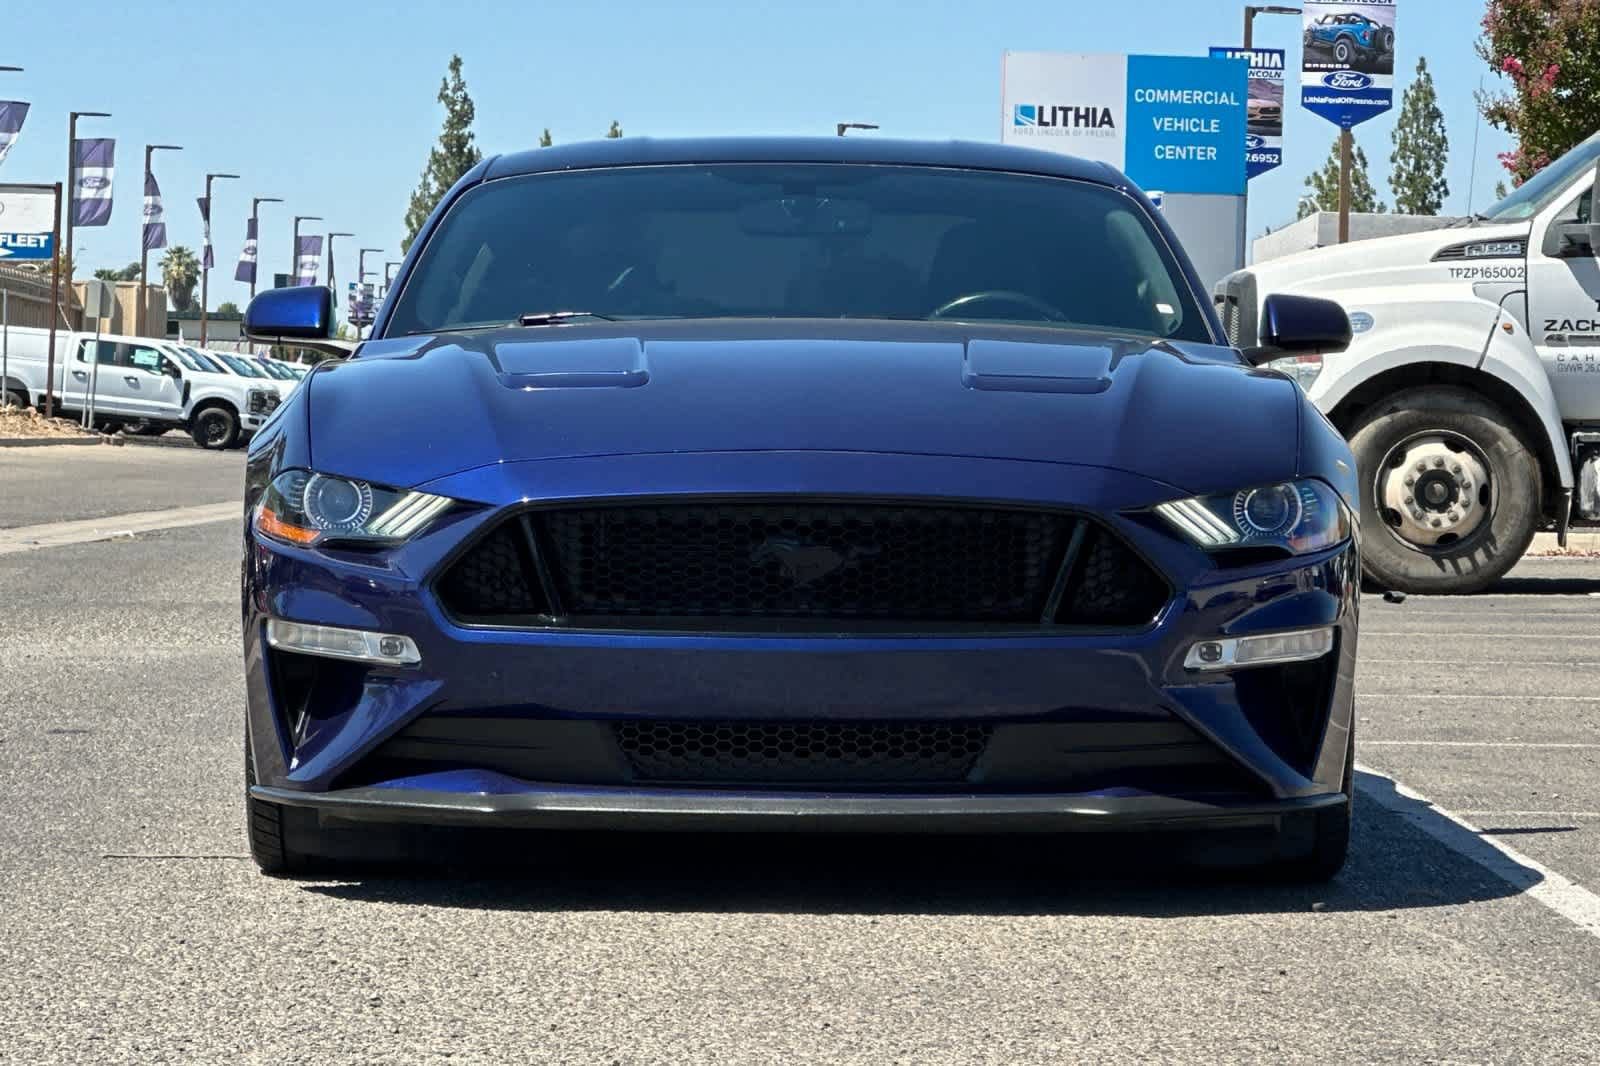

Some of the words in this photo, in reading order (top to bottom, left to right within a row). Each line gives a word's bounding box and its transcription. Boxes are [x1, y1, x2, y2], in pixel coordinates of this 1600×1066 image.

[1248, 70, 1282, 78] NCOLN
[1331, 73, 1365, 87] Ford
[1134, 88, 1240, 106] COMMERCIAL
[1037, 105, 1116, 129] LITHIA
[1038, 128, 1070, 136] LINCOLN
[1152, 117, 1221, 133] VEHICLE
[1154, 145, 1217, 161] CENTER
[1448, 266, 1525, 279] TPZP165002
